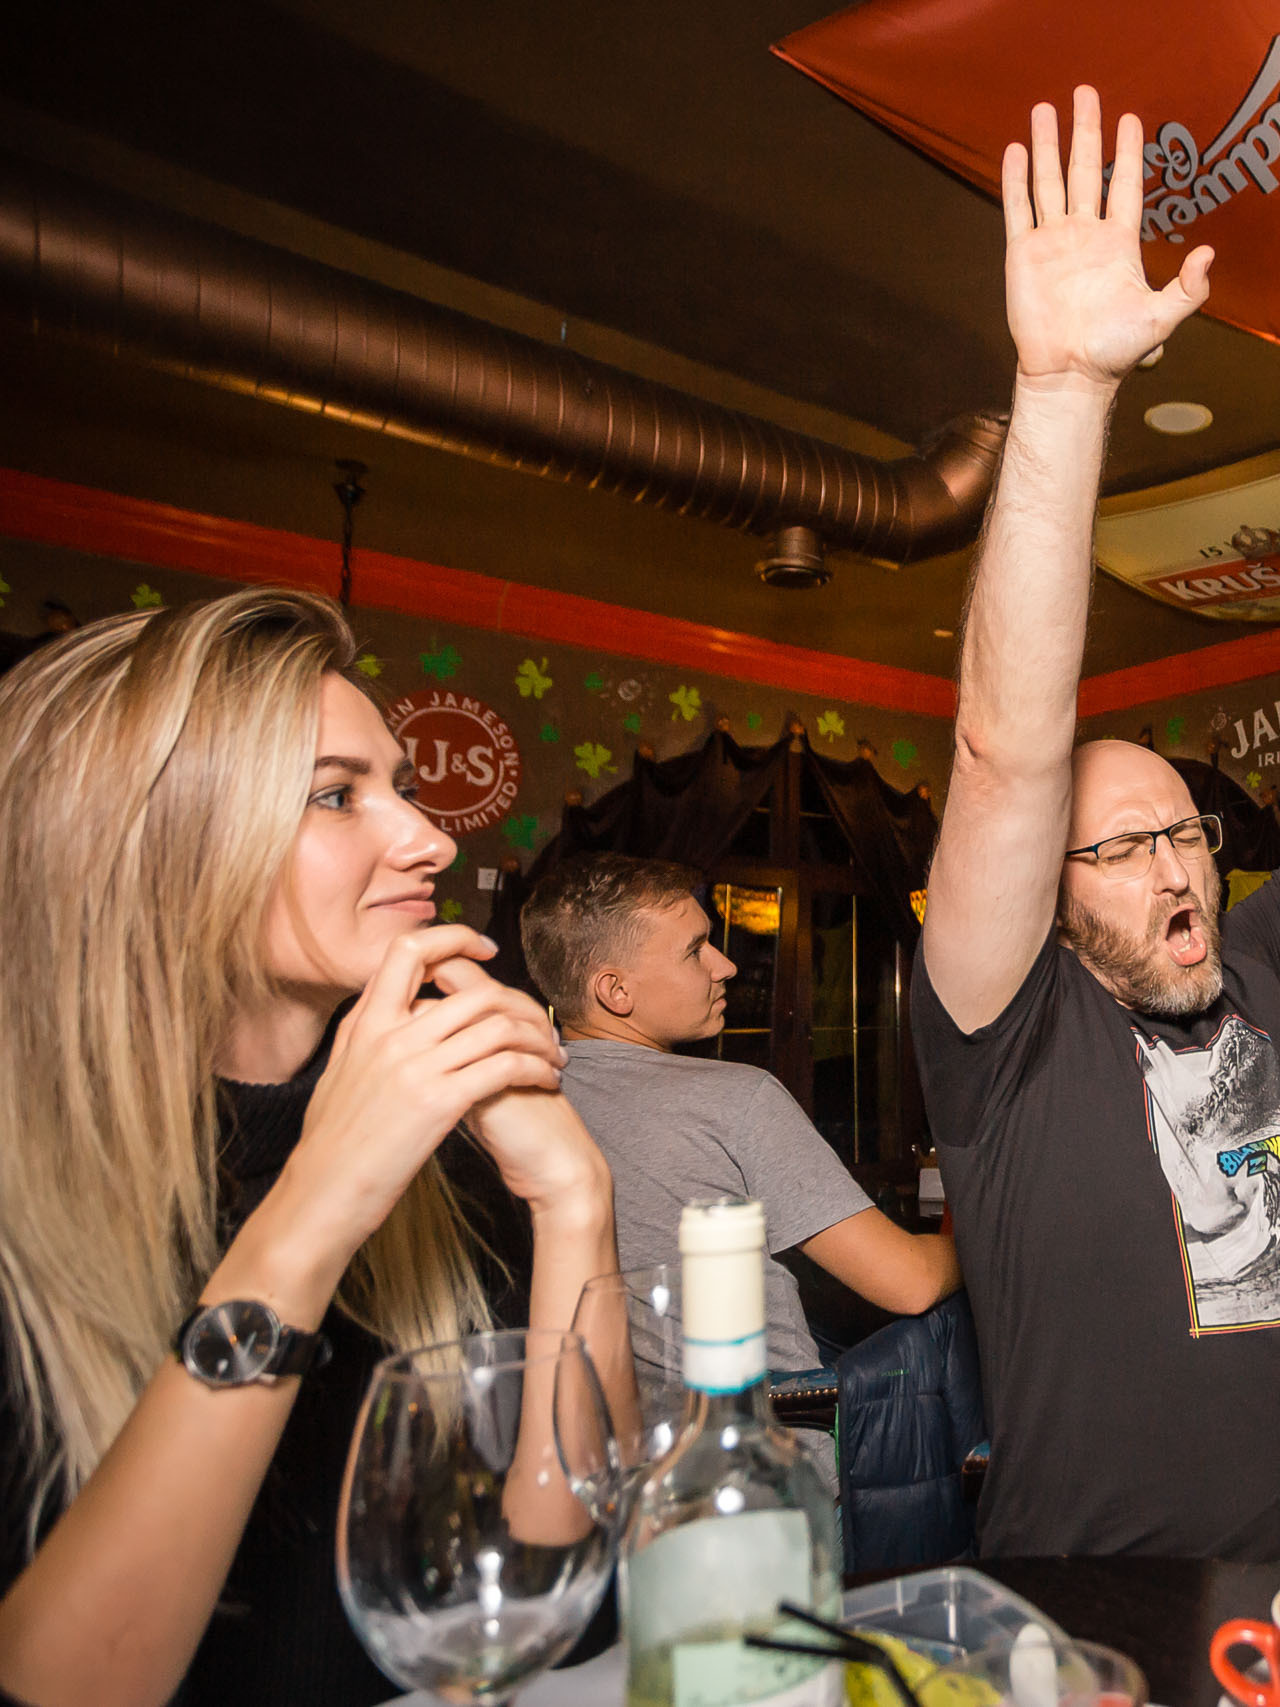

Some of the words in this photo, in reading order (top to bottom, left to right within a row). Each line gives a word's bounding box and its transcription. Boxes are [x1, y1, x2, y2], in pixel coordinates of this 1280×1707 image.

[1199, 546, 1223, 559] 15
[430, 691, 520, 766] JAMESON
[440, 785, 517, 832] LIMITED
